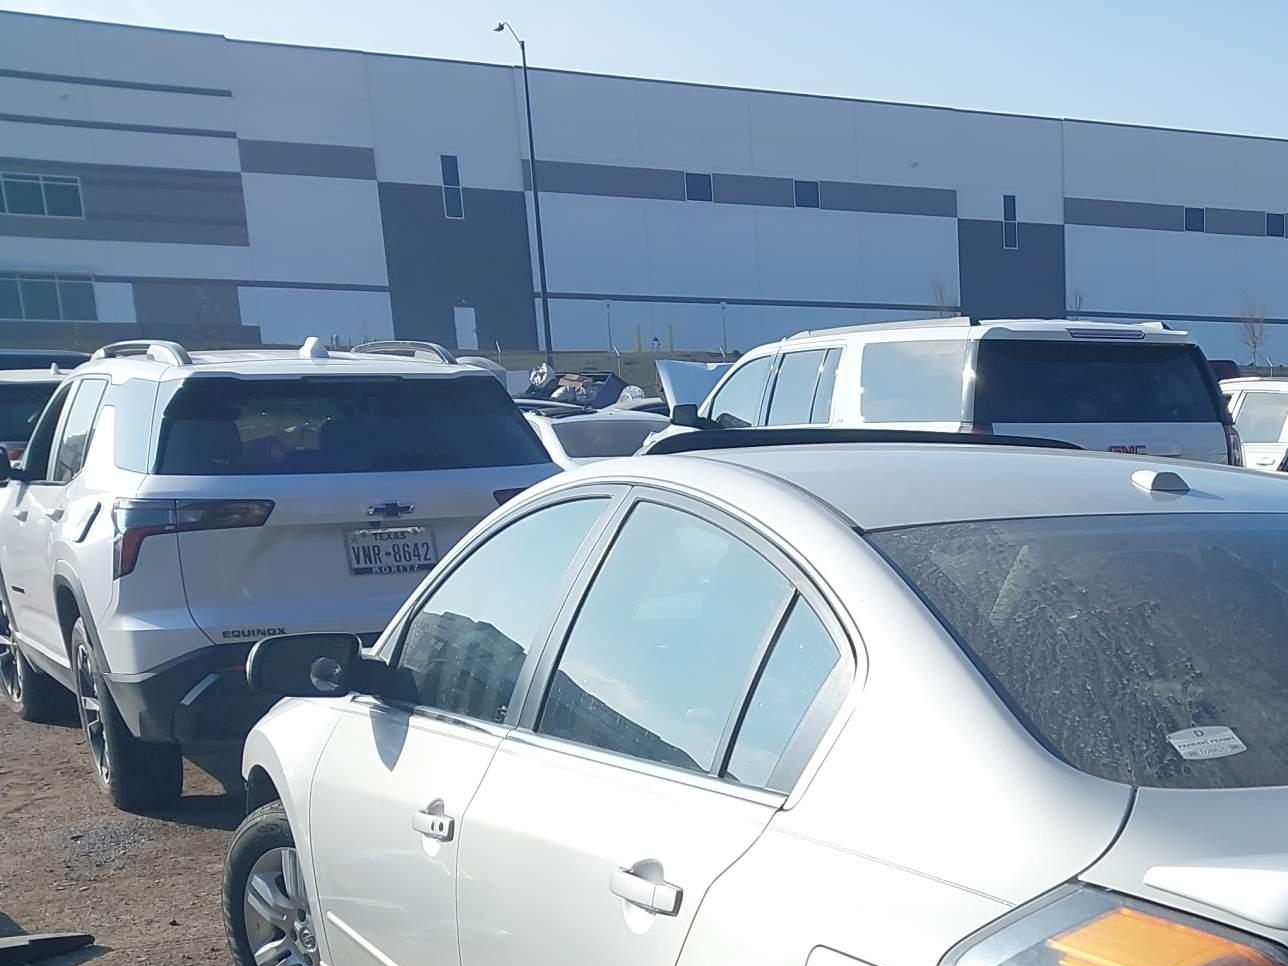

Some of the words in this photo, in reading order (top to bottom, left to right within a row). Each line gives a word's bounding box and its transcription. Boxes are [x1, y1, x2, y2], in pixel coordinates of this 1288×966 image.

[1109, 444, 1147, 455] GMC
[372, 532, 407, 541] TEXAS
[222, 627, 287, 638] EQUINOX
